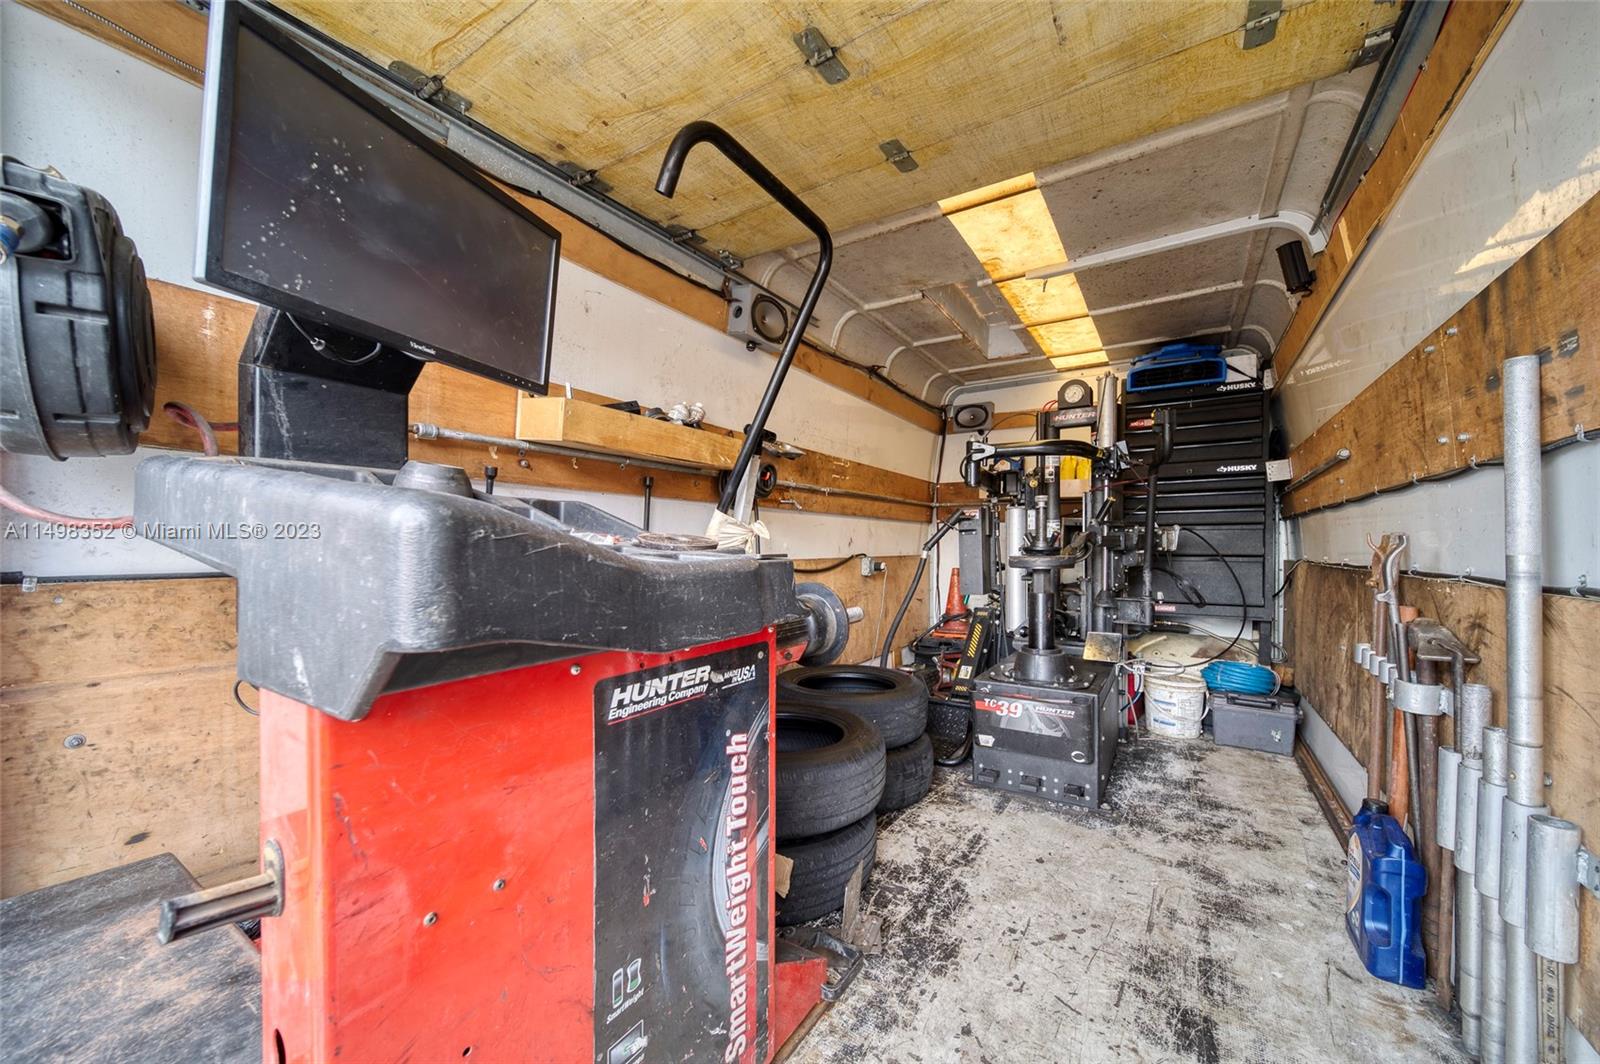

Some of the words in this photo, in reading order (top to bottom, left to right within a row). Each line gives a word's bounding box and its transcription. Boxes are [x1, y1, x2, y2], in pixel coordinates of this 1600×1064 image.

[1226, 382, 1256, 391] HUSKY
[1054, 411, 1097, 421] HUNTER
[1226, 464, 1257, 472] HUSKY
[737, 664, 756, 681] USA
[610, 665, 711, 709] HUNTER
[608, 694, 668, 720] Engineering
[667, 683, 709, 702] Company
[1035, 706, 1076, 716] HUNTER
[726, 732, 748, 837] Touch
[725, 837, 750, 1064] SmartWeight
